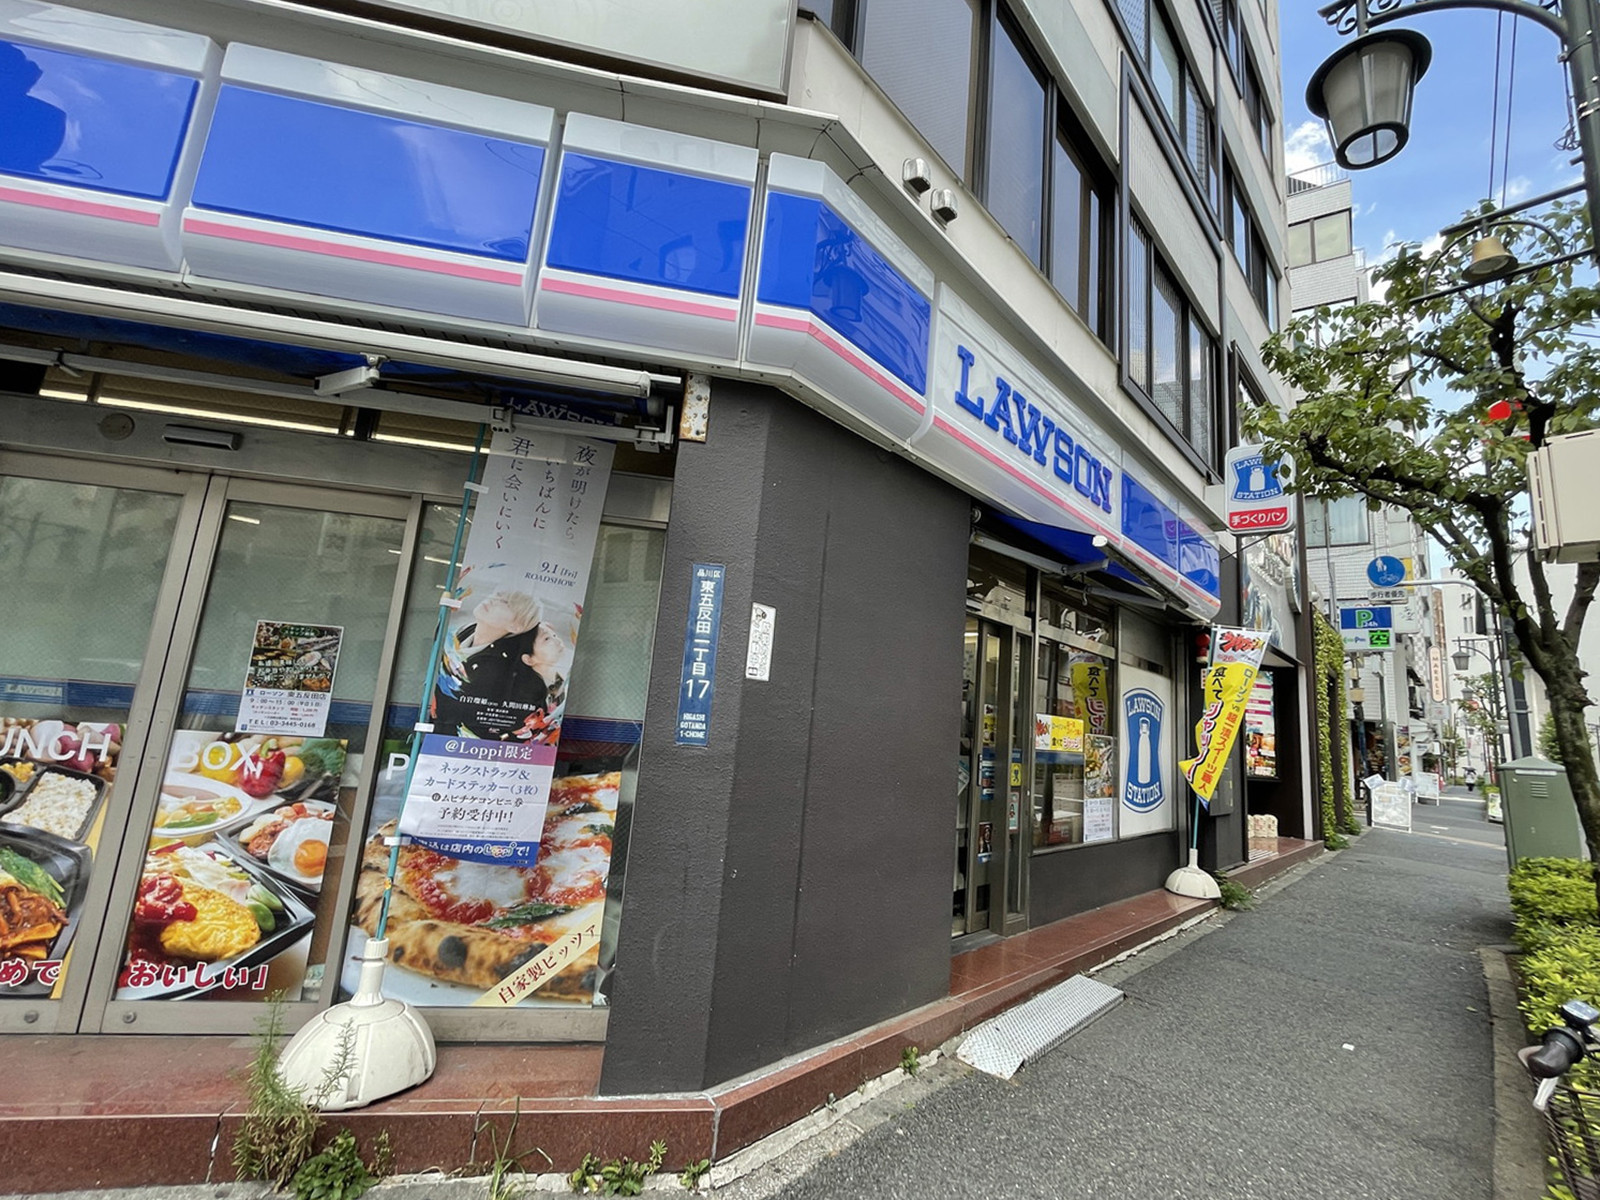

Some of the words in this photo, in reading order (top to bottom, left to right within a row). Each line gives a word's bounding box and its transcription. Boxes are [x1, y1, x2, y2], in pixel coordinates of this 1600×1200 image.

[955, 344, 1113, 514] LAWSON
[495, 436, 535, 549] 君に会いにいく
[533, 457, 560, 530] いちばんに
[1236, 487, 1279, 499] STATION
[1231, 512, 1285, 526] 手づくりパン
[541, 561, 559, 574] 9.1
[697, 569, 721, 578] 品川区
[524, 572, 576, 587] ROADSHOW
[1370, 590, 1405, 599] 歩行者優先
[1355, 609, 1374, 628] P
[692, 581, 716, 677] 東五反田一丁目
[1369, 629, 1391, 647] 空
[685, 679, 710, 698] 17
[683, 713, 706, 722] HIGASHI
[1126, 700, 1162, 722] LAWSON
[680, 721, 707, 731] GOTANDA
[680, 730, 706, 739] 1-CHOME
[441, 762, 531, 780] ネックストラップ&
[1126, 781, 1161, 804] STATION
[438, 807, 514, 823] 予約受付中!
[498, 923, 597, 1004] 自家製ピッツァ
[127, 961, 269, 991] おいしい」
